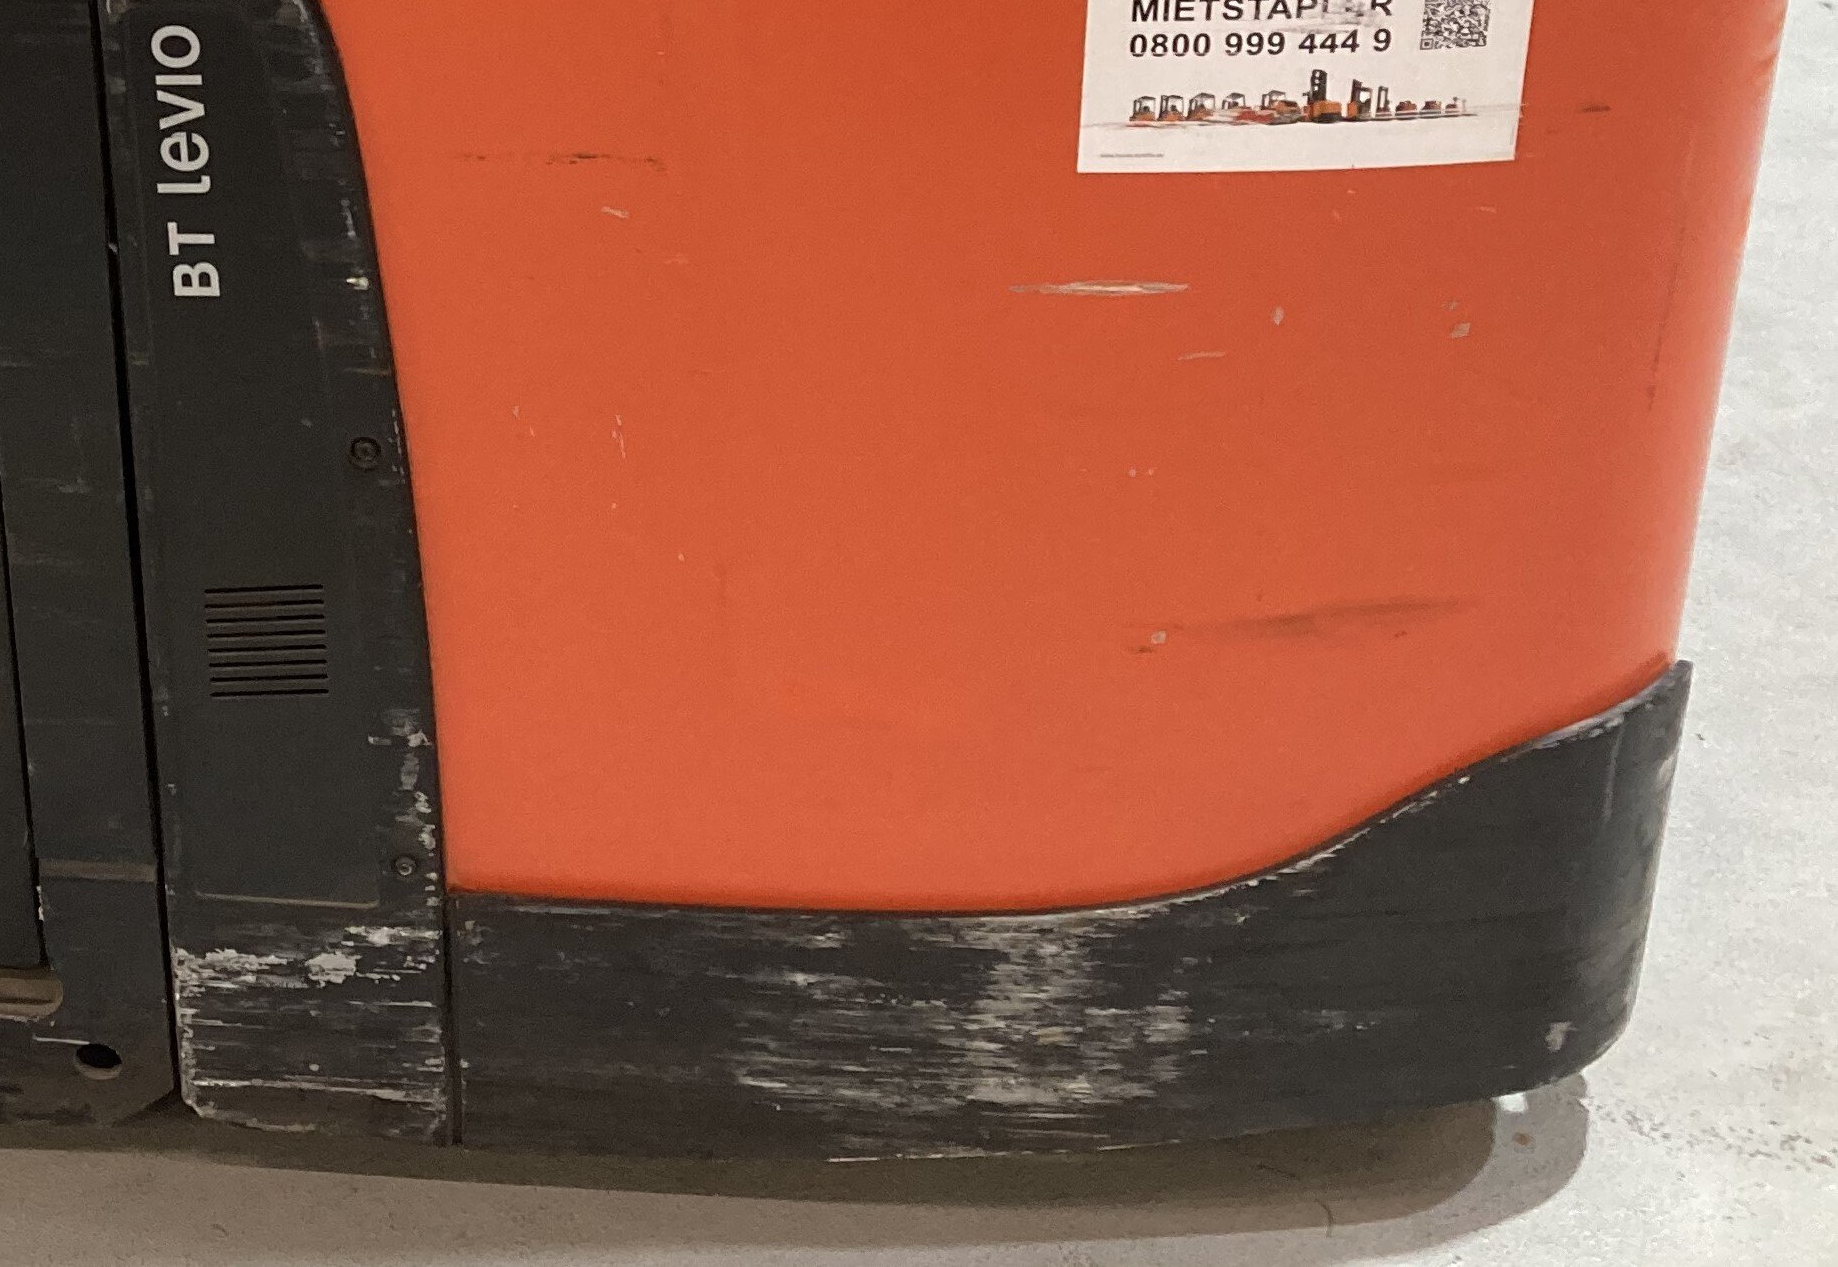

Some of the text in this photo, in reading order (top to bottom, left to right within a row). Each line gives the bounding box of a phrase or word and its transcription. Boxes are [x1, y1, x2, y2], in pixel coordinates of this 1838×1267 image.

[1129, 28, 1393, 57] 0800 999 444 9
[167, 221, 221, 297] BT
